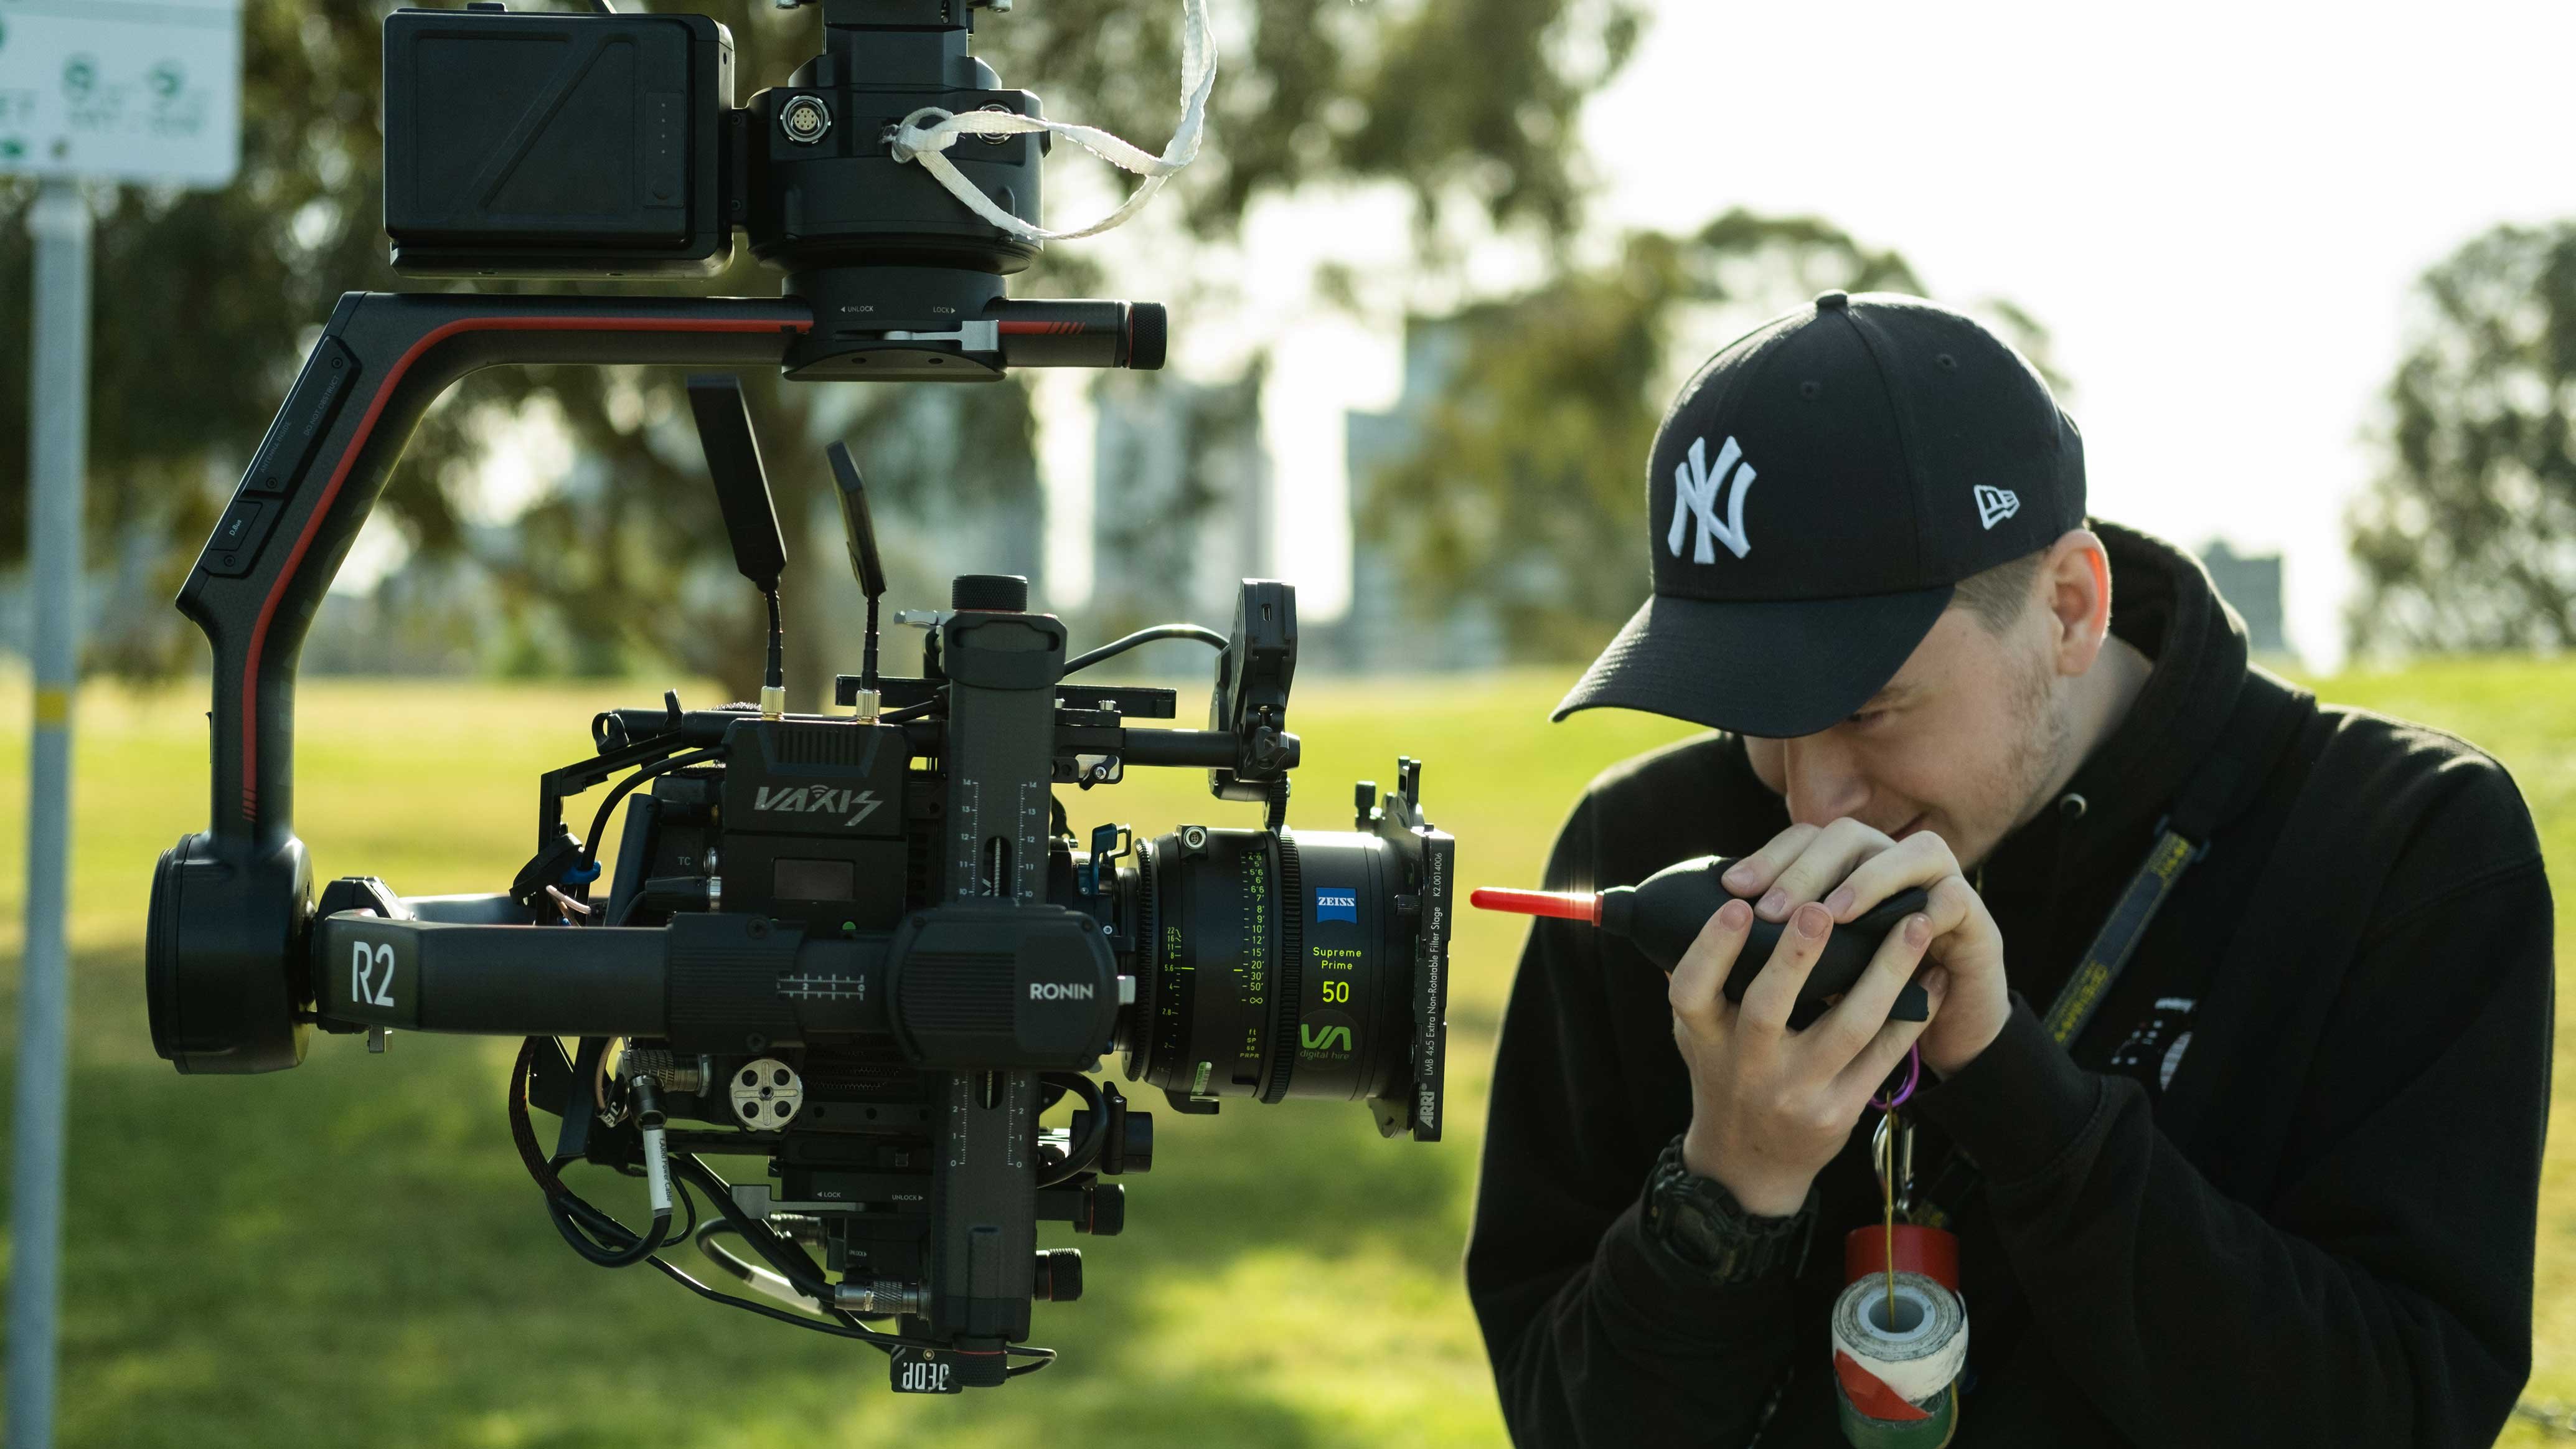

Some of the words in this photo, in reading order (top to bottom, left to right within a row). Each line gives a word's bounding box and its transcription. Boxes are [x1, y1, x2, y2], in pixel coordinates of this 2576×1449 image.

[309, 409, 321, 426] NOT
[318, 375, 339, 409] OBSTRUCT
[1667, 435, 1758, 564] NY
[754, 785, 884, 826] VAXIS
[677, 856, 692, 866] TC
[1433, 852, 1443, 897] K2.0014006
[1318, 896, 1355, 907] ZEISS
[1431, 906, 1443, 930] Stage
[1167, 927, 1175, 935] 22
[1167, 943, 1174, 951] 11
[1430, 932, 1440, 953] Filter
[1170, 951, 1175, 960] 8
[1312, 946, 1362, 959] Supreme
[1164, 963, 1174, 972] 5.6
[1321, 960, 1353, 970] Prime
[352, 940, 395, 1008] R2
[1030, 983, 1094, 1000] RONIN
[1169, 982, 1173, 990] 4
[1322, 981, 1350, 1003] 50
[1426, 955, 1440, 1015] Non-Rotatable
[1162, 1008, 1172, 1016] 2.8
[1426, 1016, 1436, 1038] Extra
[1300, 1050, 1328, 1060] digital
[1331, 1051, 1350, 1059] hire
[1426, 1040, 1435, 1057] 4x5
[1424, 1059, 1434, 1076] LMB
[1419, 1091, 1435, 1129] ARRI
[662, 1159, 670, 1181] Power
[664, 1182, 672, 1202] Cable
